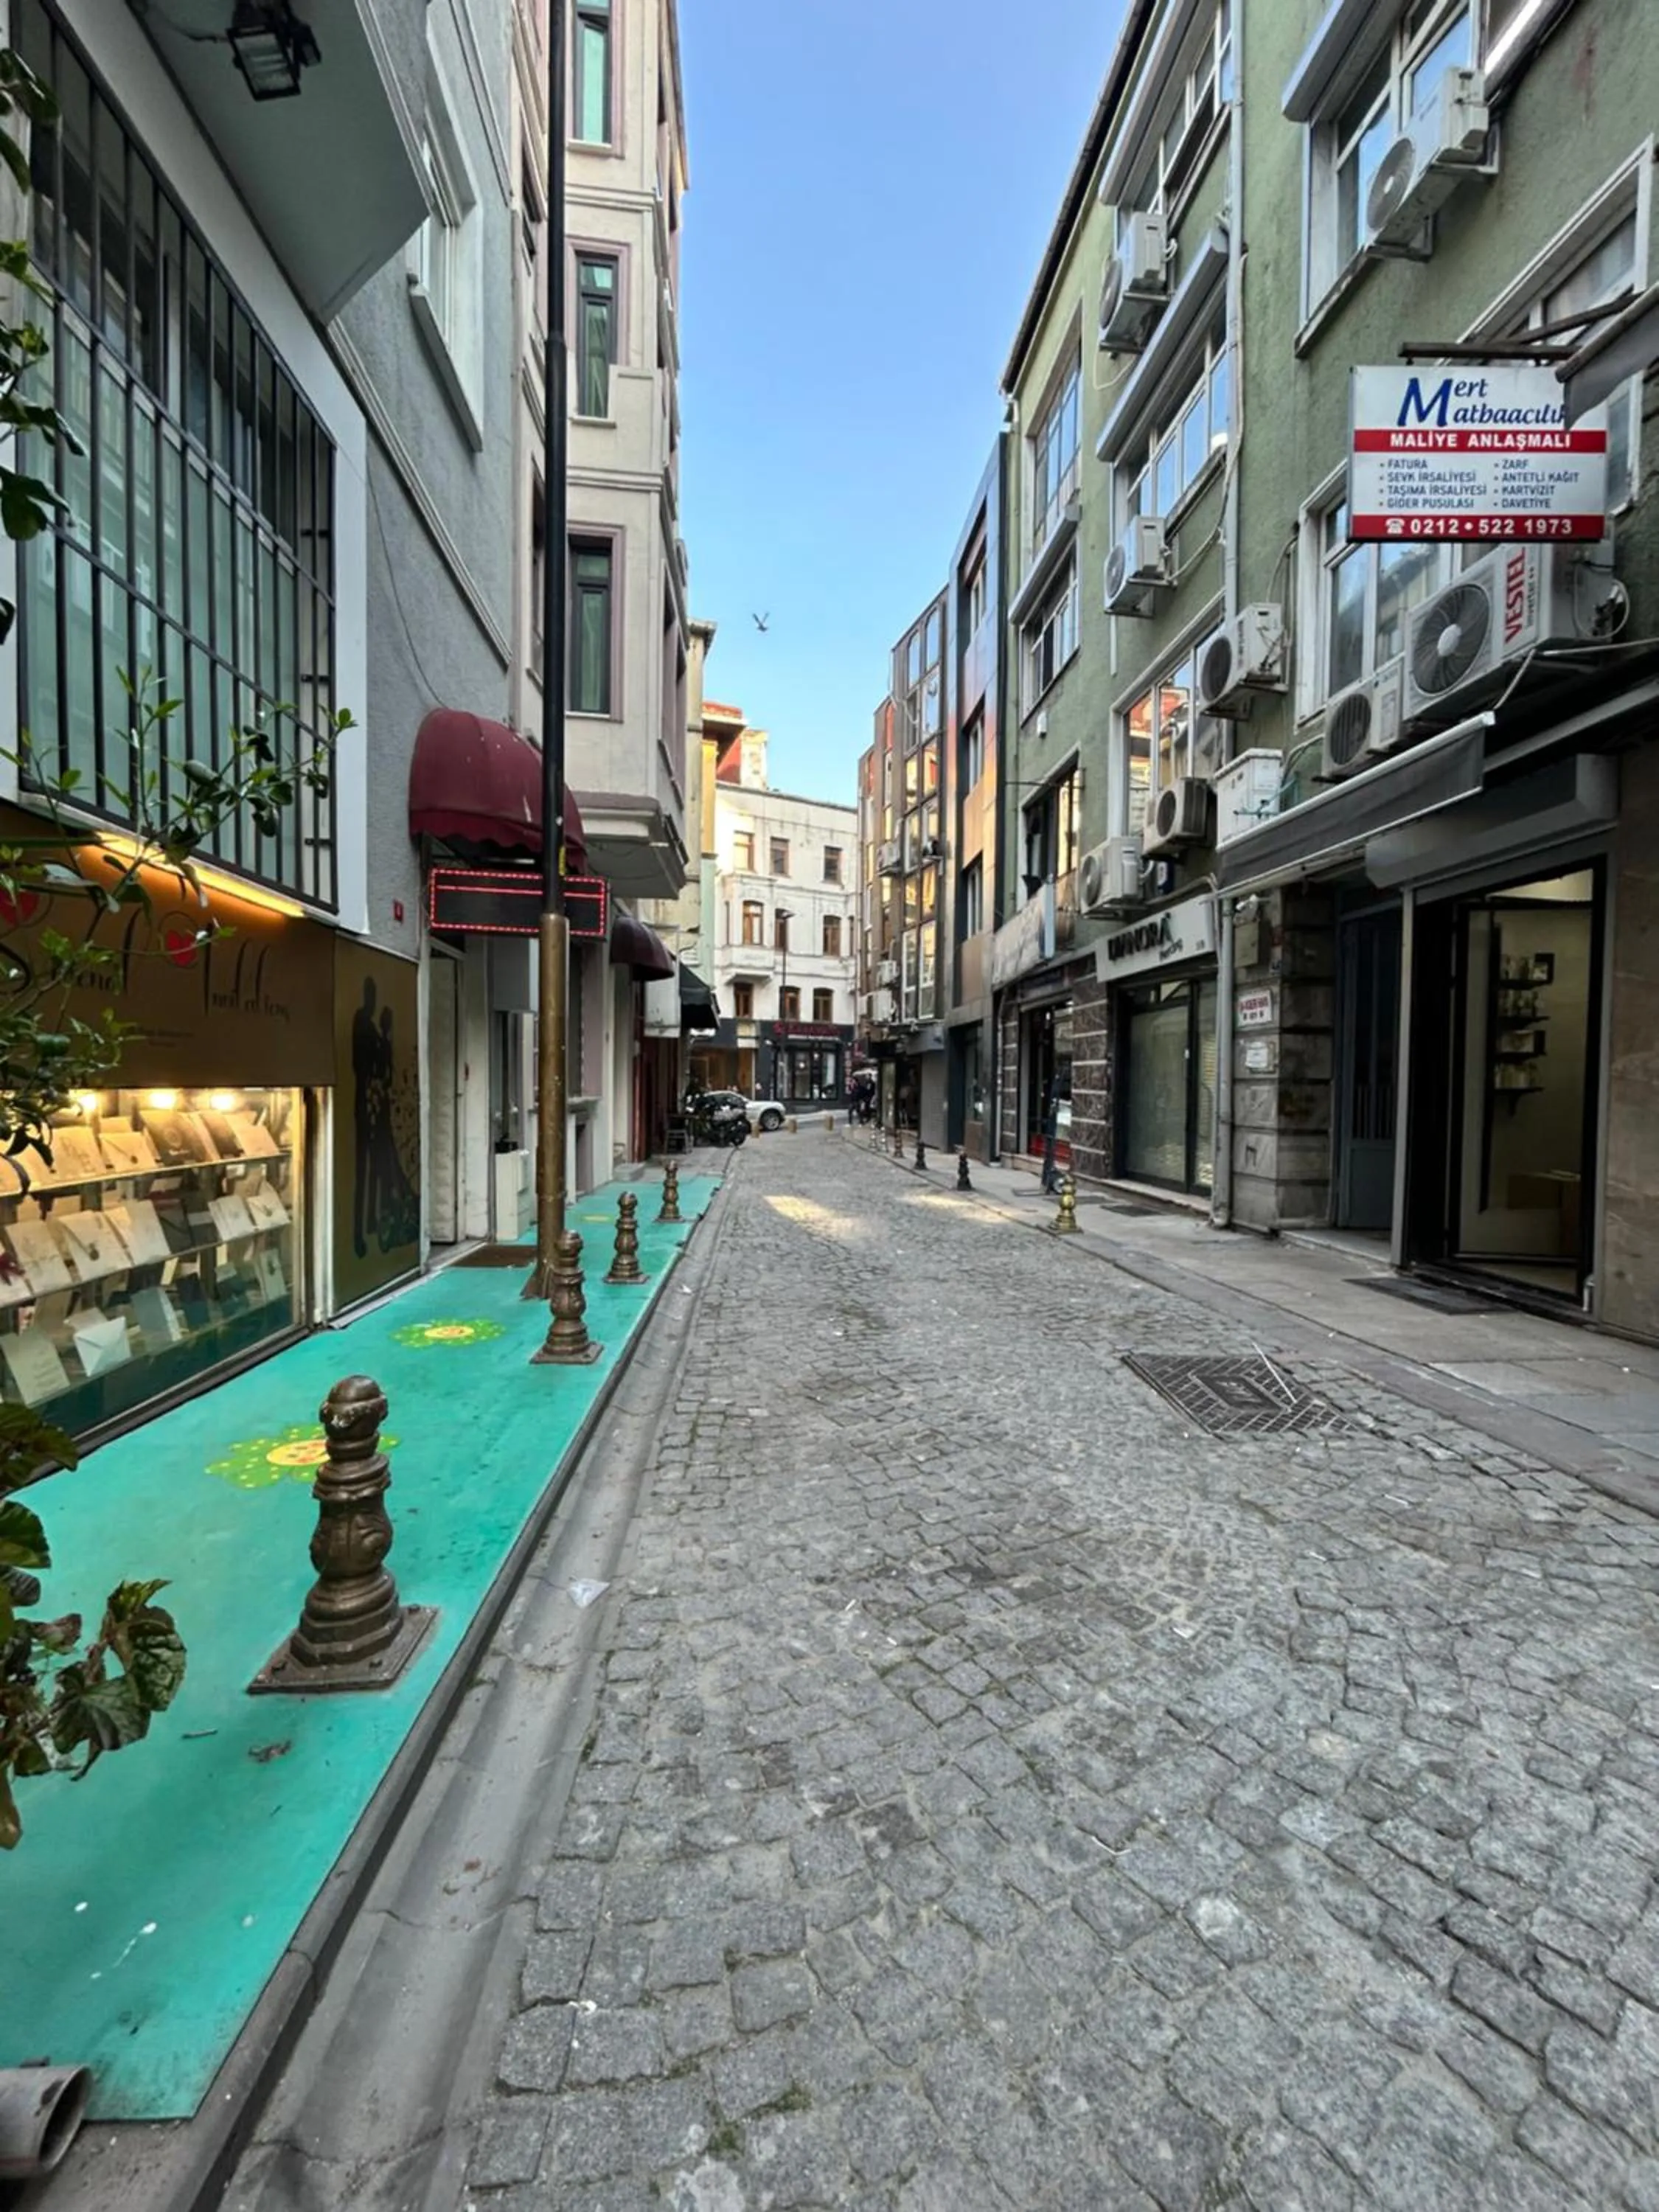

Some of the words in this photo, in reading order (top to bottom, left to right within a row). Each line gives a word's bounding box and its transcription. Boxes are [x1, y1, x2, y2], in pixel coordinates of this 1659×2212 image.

[1397, 377, 1487, 427] Mert
[1391, 431, 1458, 448] MALİYE
[1467, 433, 1571, 451] ANLAŞMALI
[1388, 459, 1428, 469] FATURA
[1502, 459, 1528, 469] ZARF
[1388, 472, 1415, 482] SEVK
[1419, 470, 1476, 482] İRSALİYESİ
[1548, 470, 1579, 482] KAĞIT
[1388, 485, 1426, 496] TAŞIMA
[1430, 484, 1487, 495] İRSALİYESİ
[1387, 497, 1419, 508] GİDER
[1422, 498, 1475, 508] PUSULASI
[1411, 518, 1459, 534] 0212
[1478, 518, 1514, 534] 522
[1524, 518, 1572, 534] 1973
[1506, 546, 1526, 644] VESTEL
